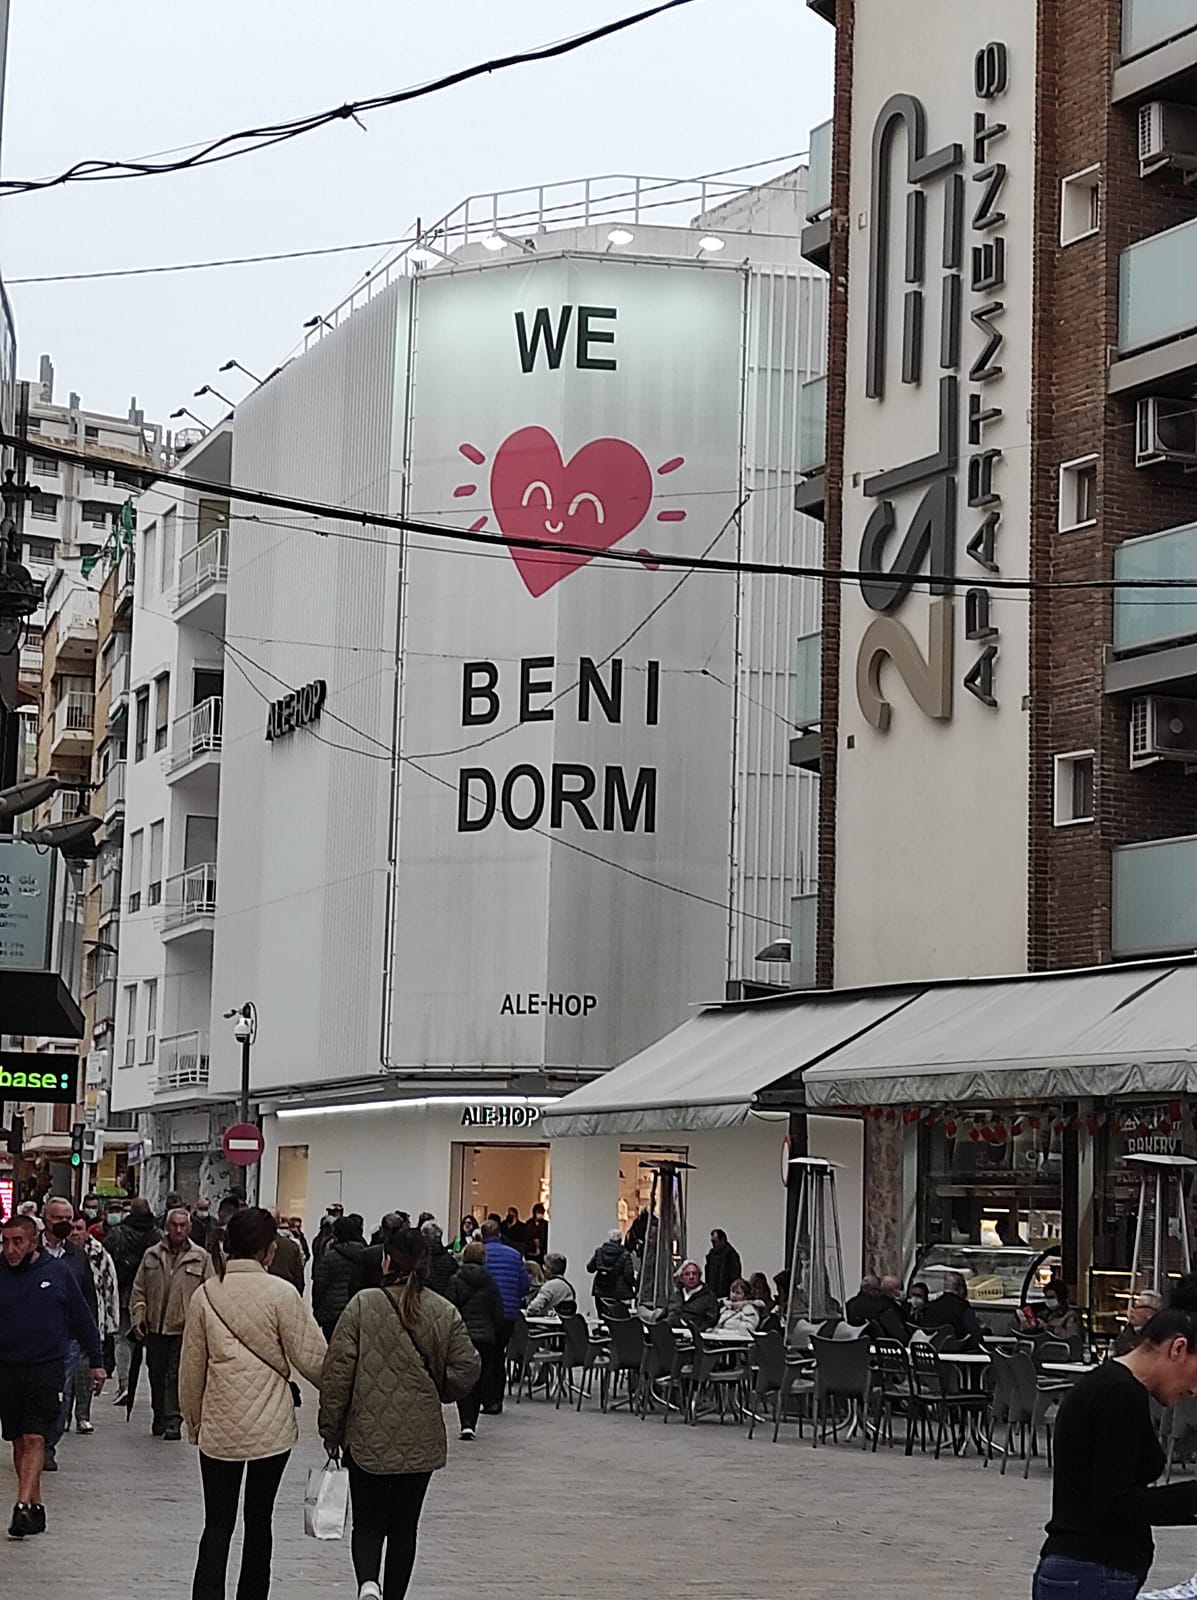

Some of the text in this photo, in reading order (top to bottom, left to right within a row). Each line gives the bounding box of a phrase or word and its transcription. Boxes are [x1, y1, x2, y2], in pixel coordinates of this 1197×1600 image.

[514, 304, 617, 373] WE
[964, 42, 1007, 708] APARTMENTS
[462, 655, 659, 727] BENI
[457, 762, 657, 833] DORM
[500, 993, 597, 1016] ALE-HOP
